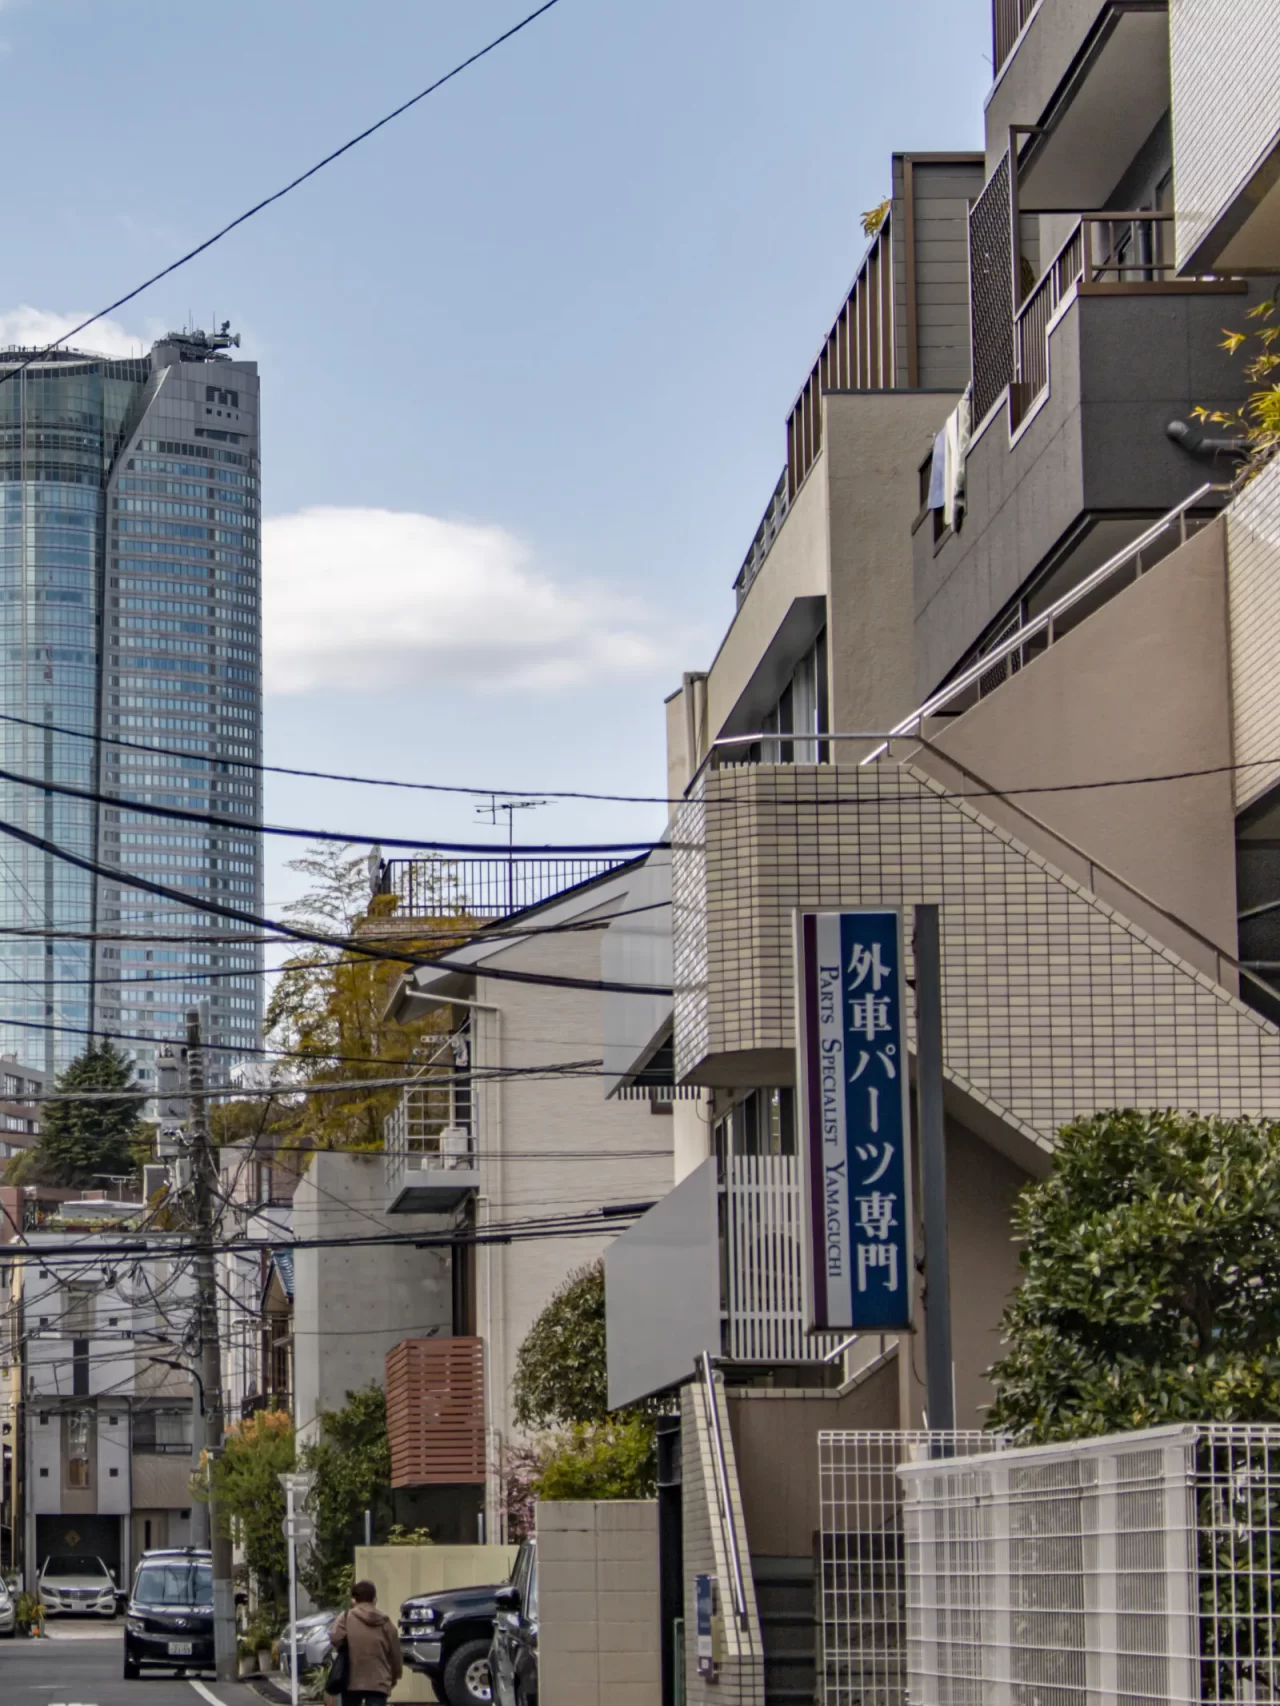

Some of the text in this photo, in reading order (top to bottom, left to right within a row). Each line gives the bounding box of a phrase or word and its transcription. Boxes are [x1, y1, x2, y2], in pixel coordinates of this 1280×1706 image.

[206, 407, 239, 421] MORI
[847, 942, 899, 1292] 外車パーツ専門
[825, 1160, 846, 1278] YAMAGUCHI
